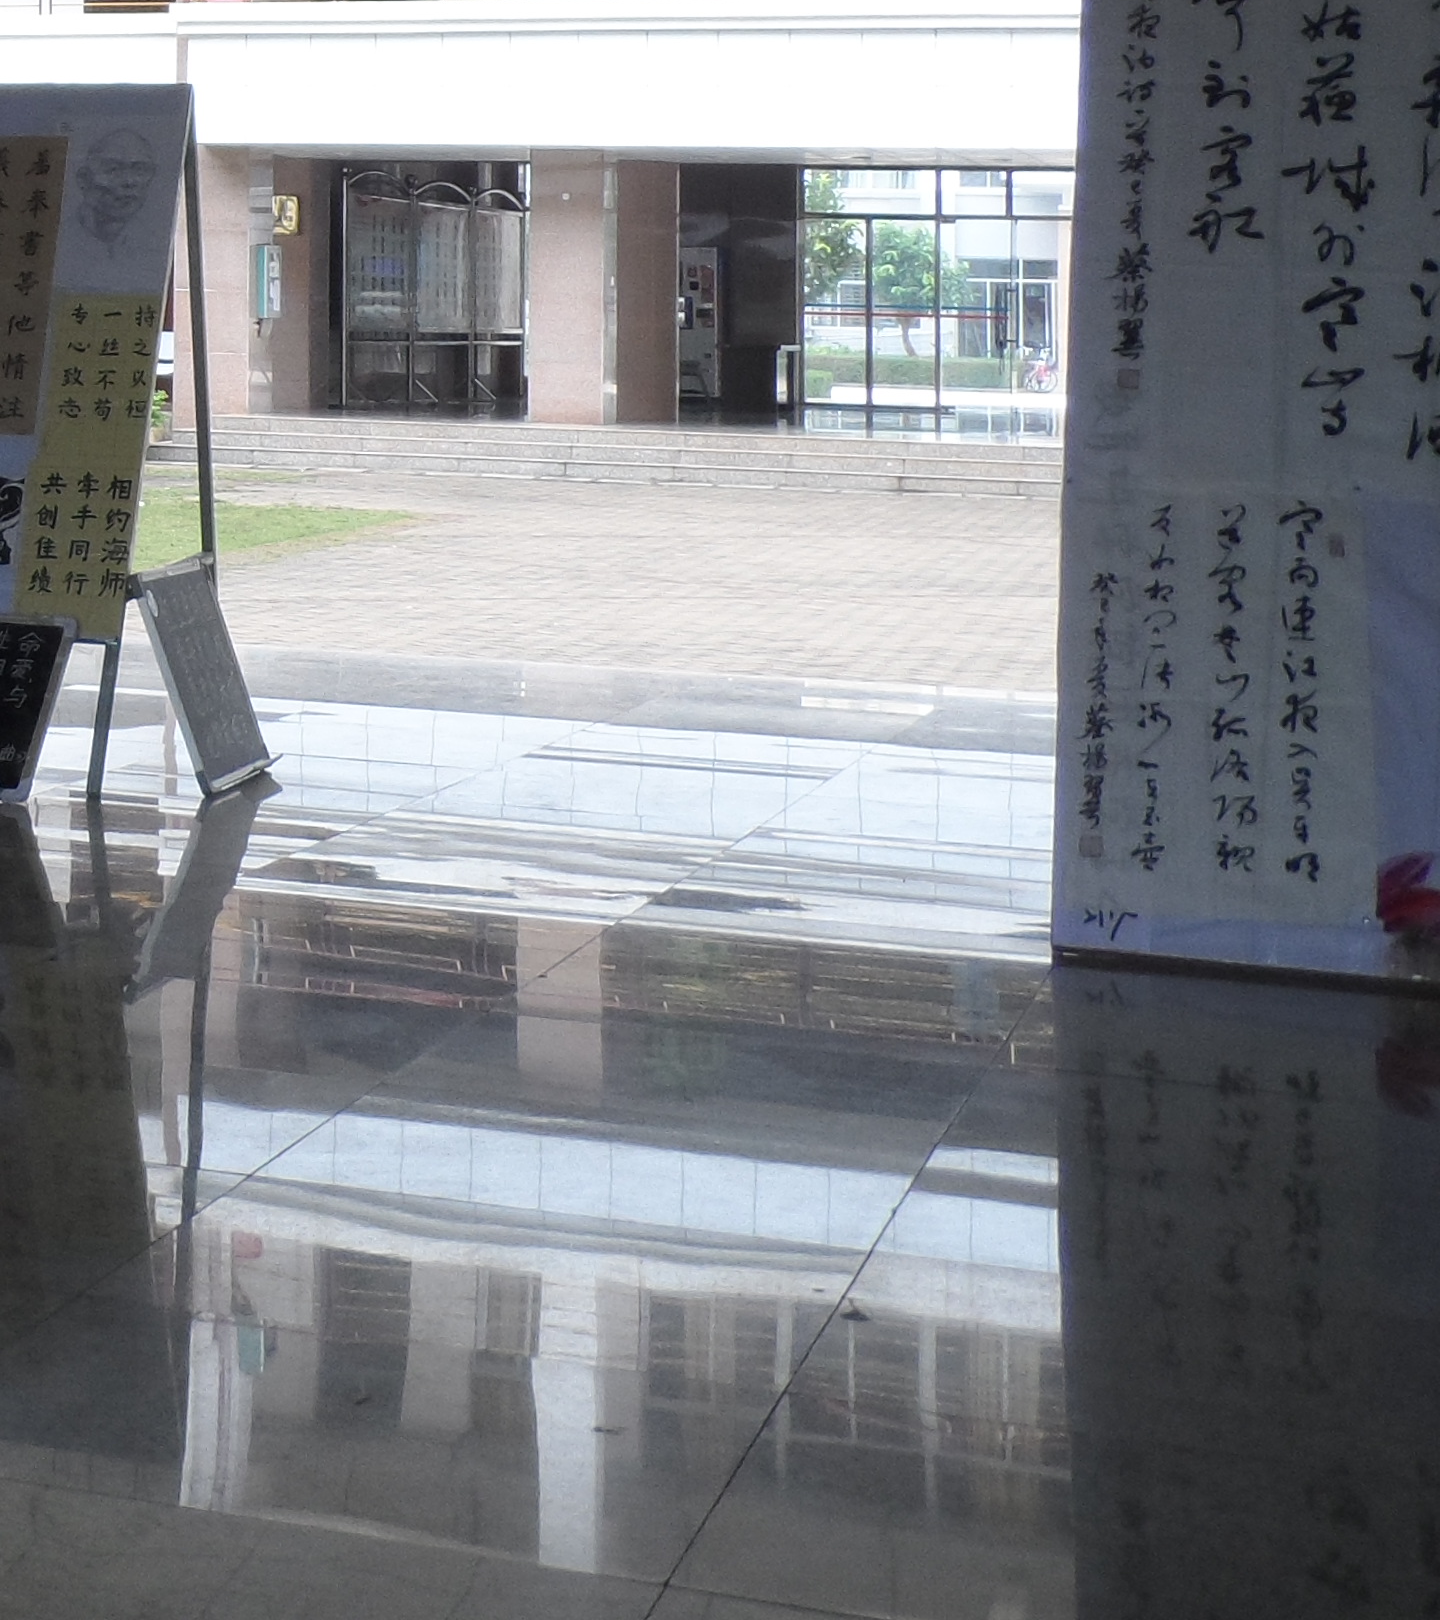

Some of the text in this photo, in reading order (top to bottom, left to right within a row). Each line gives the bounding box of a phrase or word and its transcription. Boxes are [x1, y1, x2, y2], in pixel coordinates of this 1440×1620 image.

[58, 303, 91, 419] 专心致志
[94, 310, 123, 421] 一丝不苟
[125, 305, 157, 420] 持之以恒
[27, 472, 68, 595] 共创佳绩
[64, 470, 99, 596] 牵手同行
[98, 477, 133, 598] 相约海师
